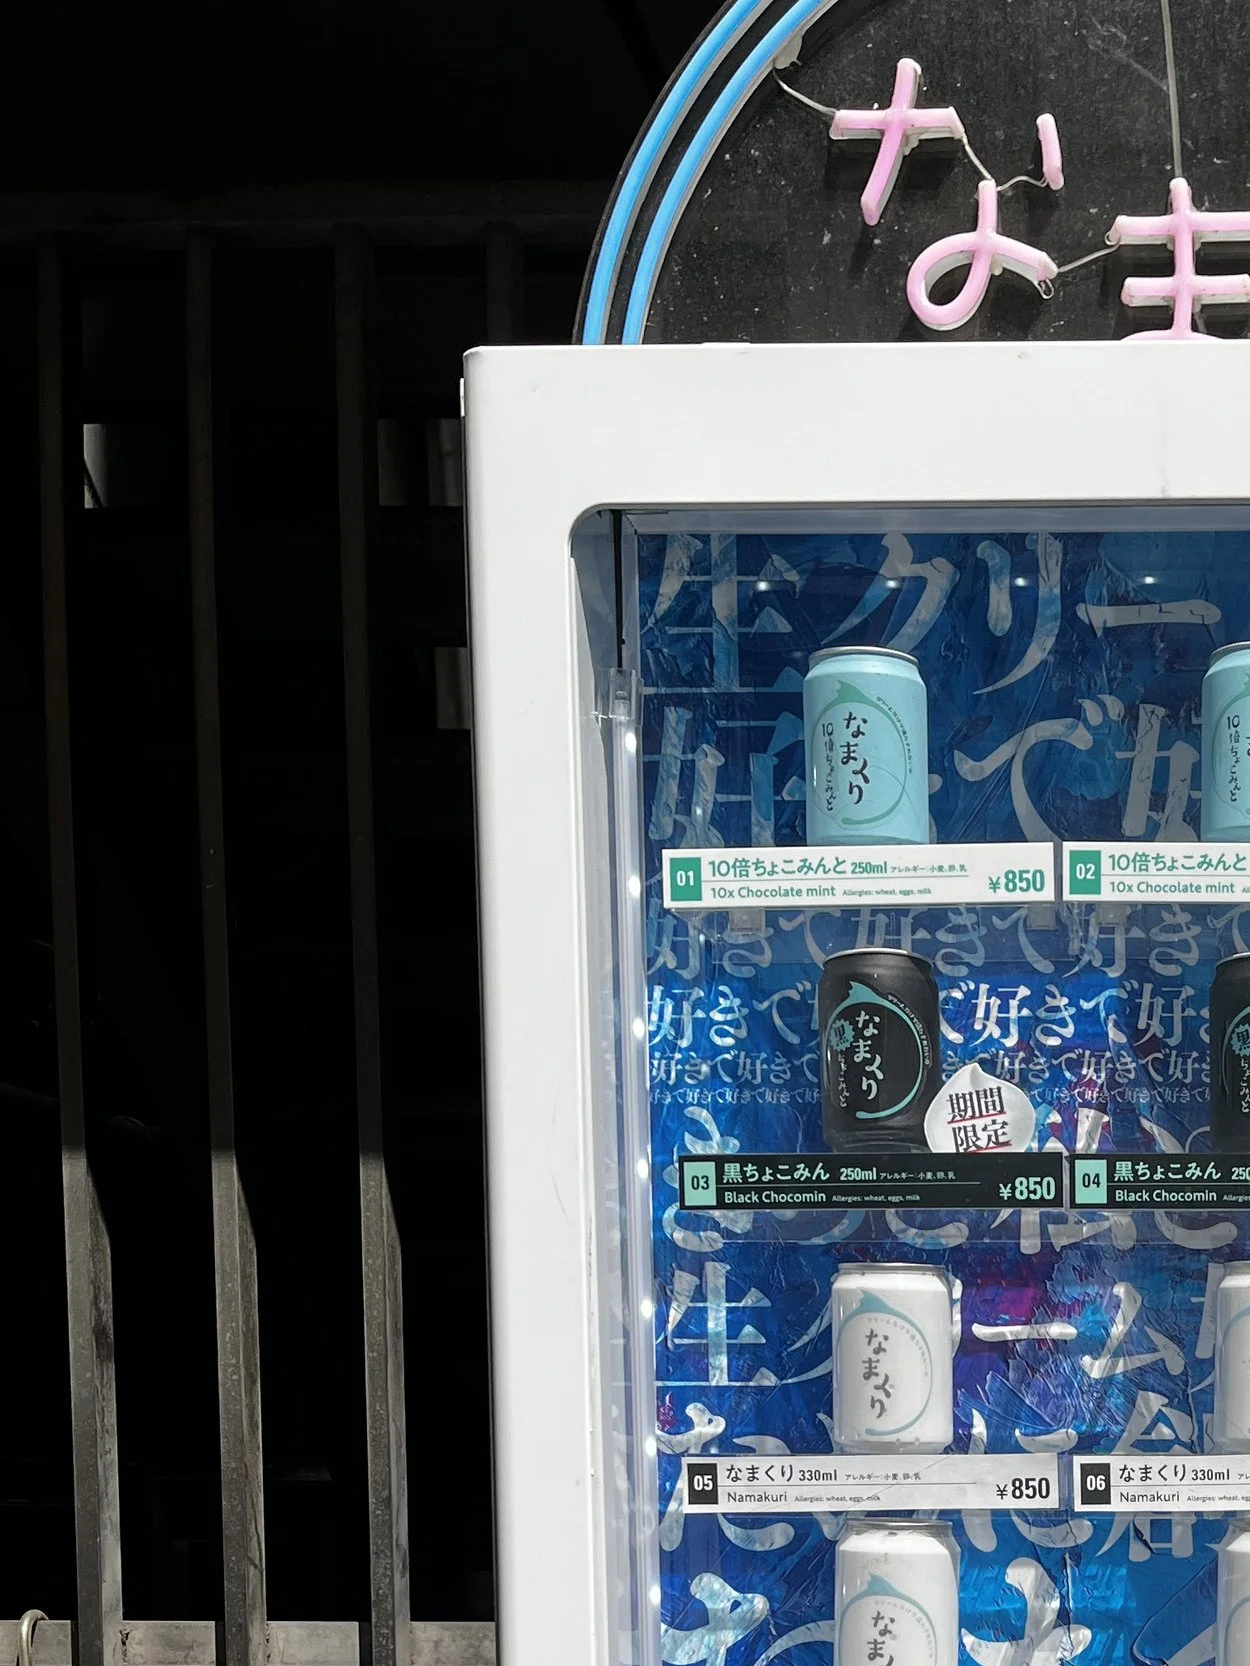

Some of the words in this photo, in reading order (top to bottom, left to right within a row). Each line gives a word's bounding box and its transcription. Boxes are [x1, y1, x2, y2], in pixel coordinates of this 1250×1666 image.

[839, 712, 870, 805] なまくり
[709, 857, 846, 877] 10倍ちょこみんと
[851, 861, 887, 875] 250ml
[1076, 863, 1095, 879] 02
[1109, 852, 1247, 872] 10倍ちょこみんと
[676, 870, 695, 886] 01
[988, 869, 1045, 894] ¥850
[711, 887, 735, 899] 10x
[737, 885, 802, 898] Chocolate
[807, 885, 836, 897] mint
[1110, 881, 1133, 893] 10x
[1137, 881, 1202, 894] Chocolate
[1205, 881, 1235, 893] mint
[852, 1010, 885, 1100] なまくり
[947, 1086, 1003, 1121] 期間
[952, 1120, 1011, 1152] 限定
[722, 1162, 829, 1183] 黒ちょこみん
[840, 1167, 877, 1182] 250ml
[1114, 1161, 1221, 1181] 黒ちょこみん
[691, 1175, 710, 1191] 03
[999, 1177, 1055, 1201] ¥850
[1082, 1173, 1101, 1189] 04
[724, 1190, 760, 1204] Black
[762, 1189, 826, 1204] Chocomin
[1115, 1189, 1150, 1203] Black
[1153, 1188, 1217, 1203] Chocomin
[862, 1328, 896, 1419] なまくり
[726, 1464, 793, 1482] なまくり
[799, 1469, 838, 1482] 330ml
[1119, 1463, 1186, 1482] なまくり
[1192, 1468, 1230, 1481] 330ml
[694, 1475, 713, 1491] 05
[996, 1477, 1050, 1500] ¥850
[1086, 1475, 1106, 1491] 06
[727, 1491, 787, 1503] Namakuri
[1120, 1490, 1180, 1502] Namakuri
